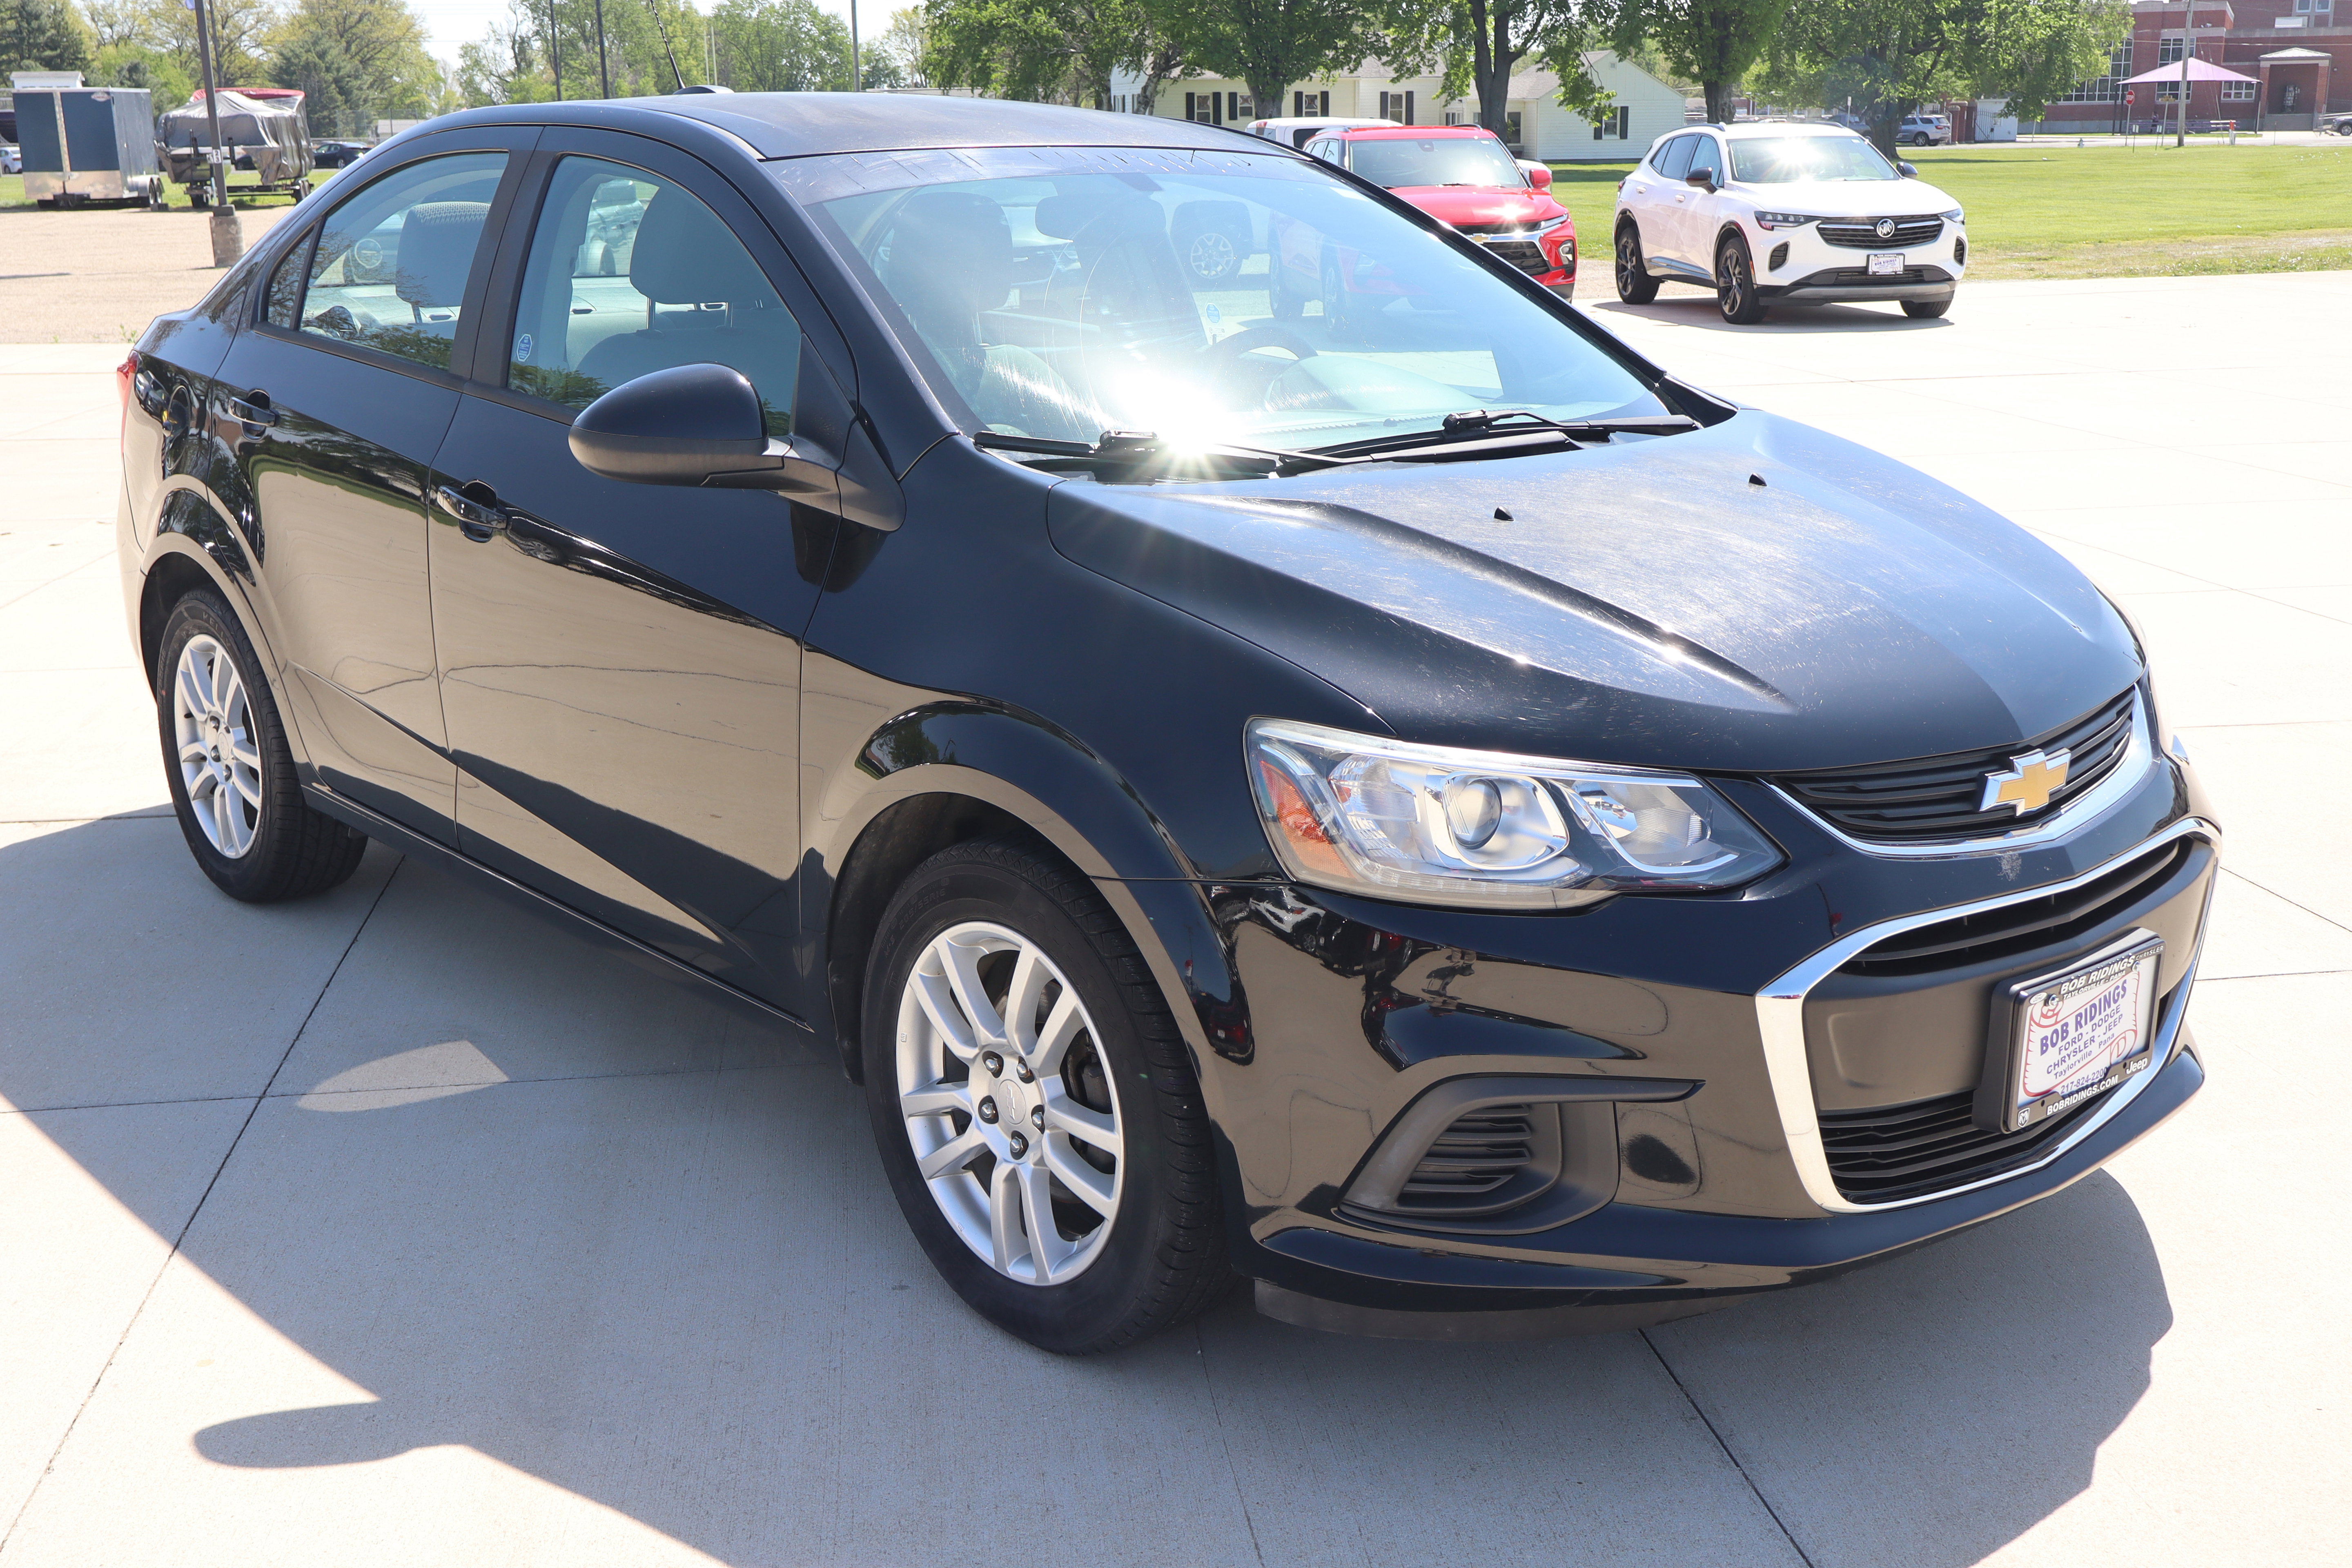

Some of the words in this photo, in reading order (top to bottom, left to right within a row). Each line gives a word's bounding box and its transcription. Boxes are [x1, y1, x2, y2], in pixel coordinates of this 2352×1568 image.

[2135, 945, 2164, 960] CHRYSLER
[2060, 975, 2086, 995] BOB
[2088, 955, 2136, 983] RIDINGS
[2063, 980, 2105, 1000] TAYLORVILLE
[2109, 970, 2126, 982] PANA
[2040, 1021, 2069, 1056] BOB
[2074, 979, 2127, 1033] RIDINGS
[2058, 1035, 2083, 1056] FORD
[2091, 1004, 2121, 1032] DODGE
[2046, 1035, 2096, 1075] CHRYSLER
[2103, 1013, 2123, 1040] JEEP
[2054, 1050, 2092, 1080] Taylorville
[2098, 1032, 2115, 1049] Pana
[2060, 1067, 2107, 1095] 217-824-2200
[2125, 1057, 2148, 1075] Jeep
[2047, 1074, 2119, 1116] BOBRIDINGS.COM
